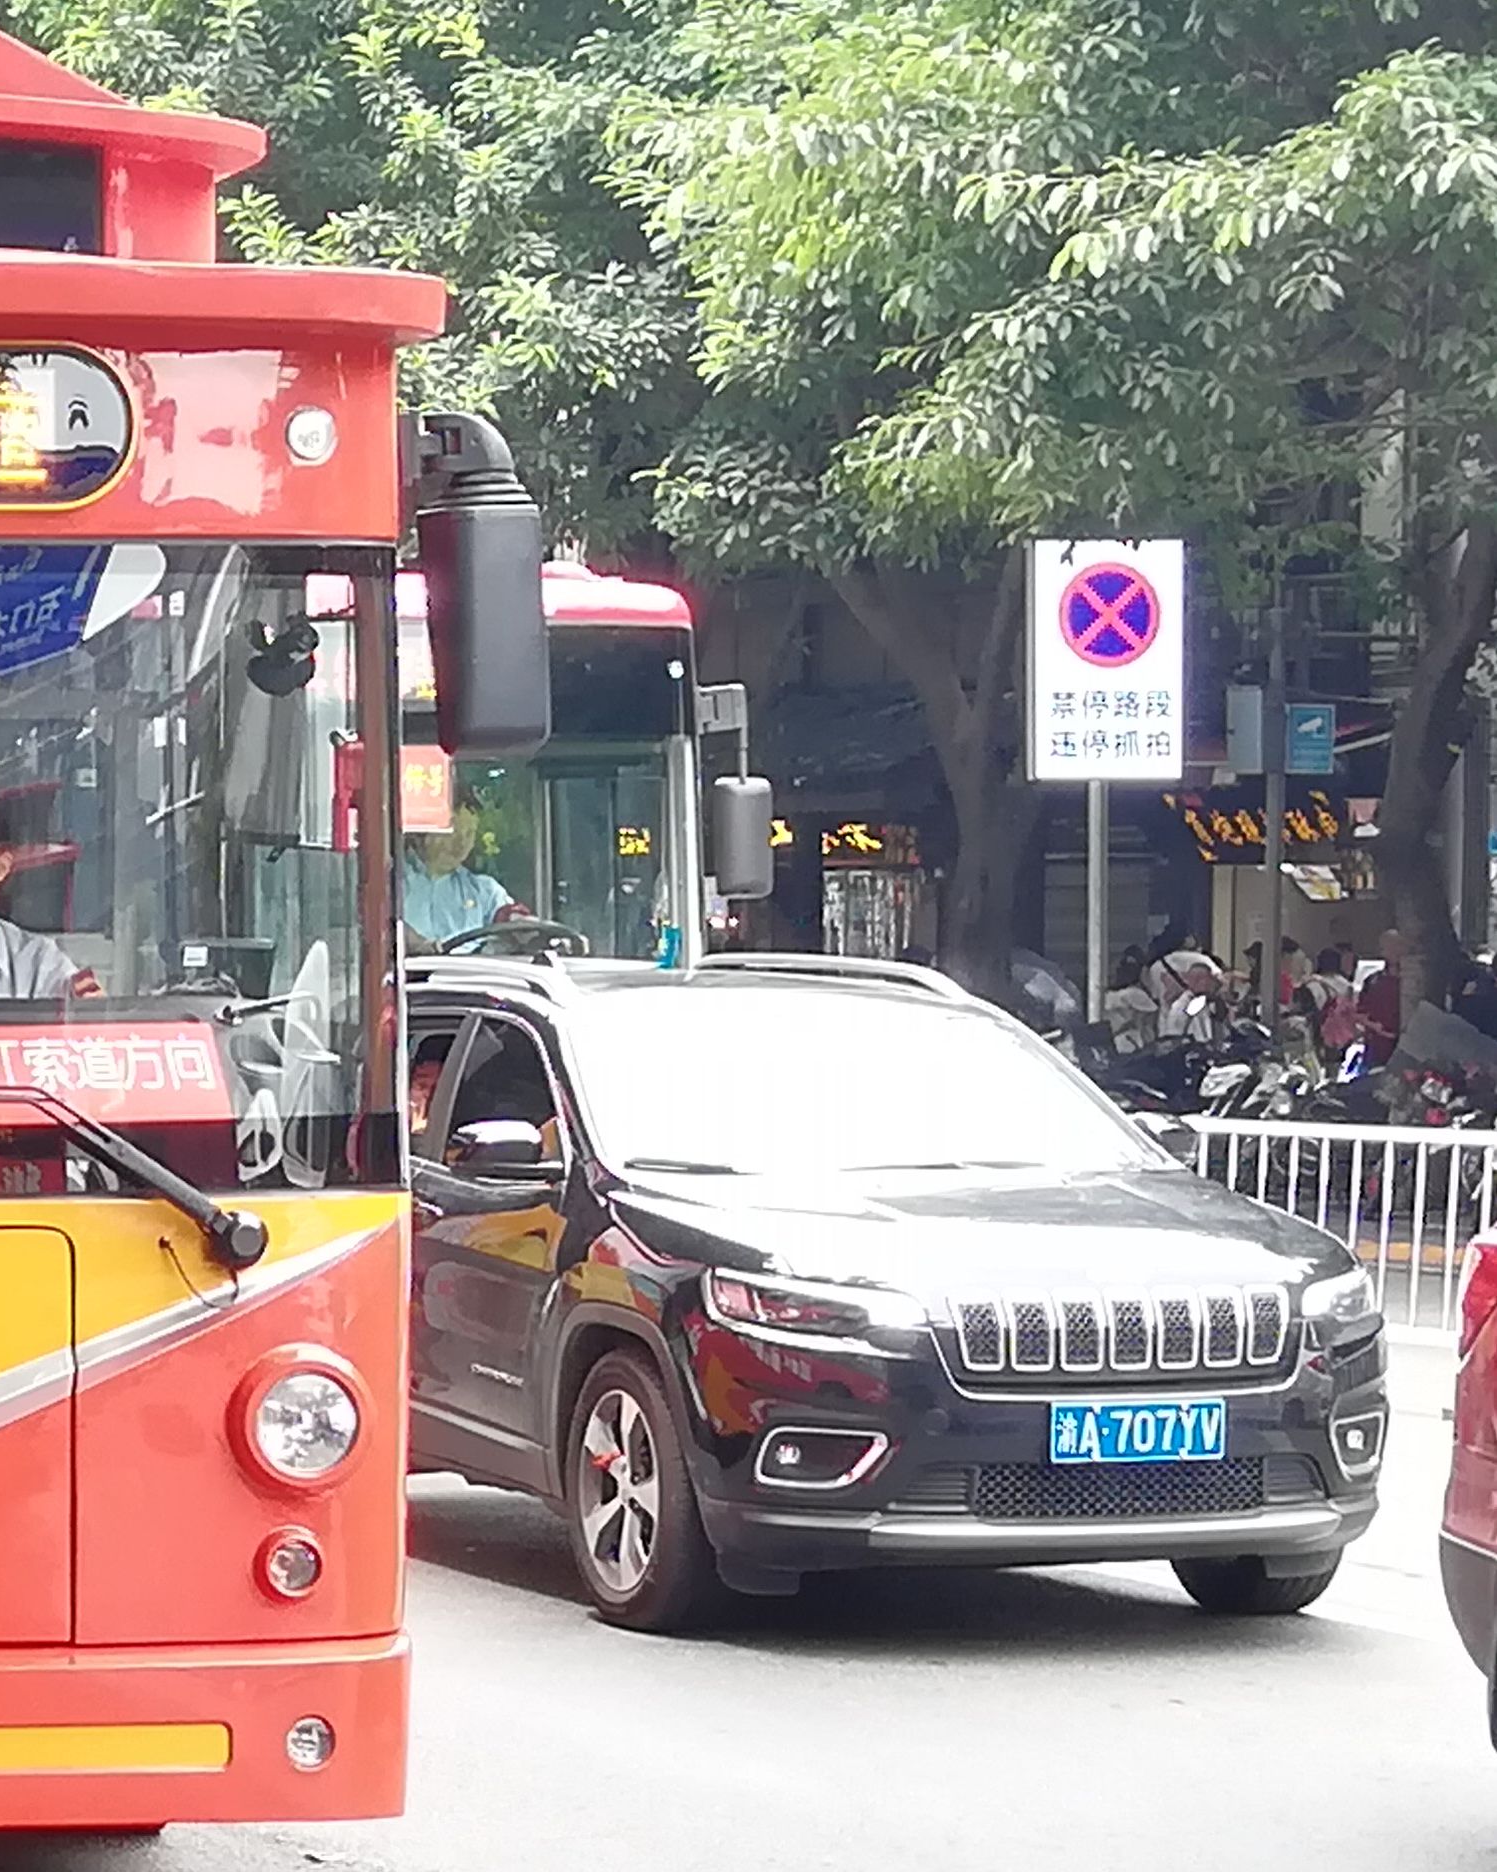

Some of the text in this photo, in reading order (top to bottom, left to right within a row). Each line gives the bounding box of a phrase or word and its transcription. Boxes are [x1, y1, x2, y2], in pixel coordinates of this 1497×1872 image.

[1050, 690, 1173, 719] 禁停路段
[1050, 730, 1172, 759] 违停抓拍
